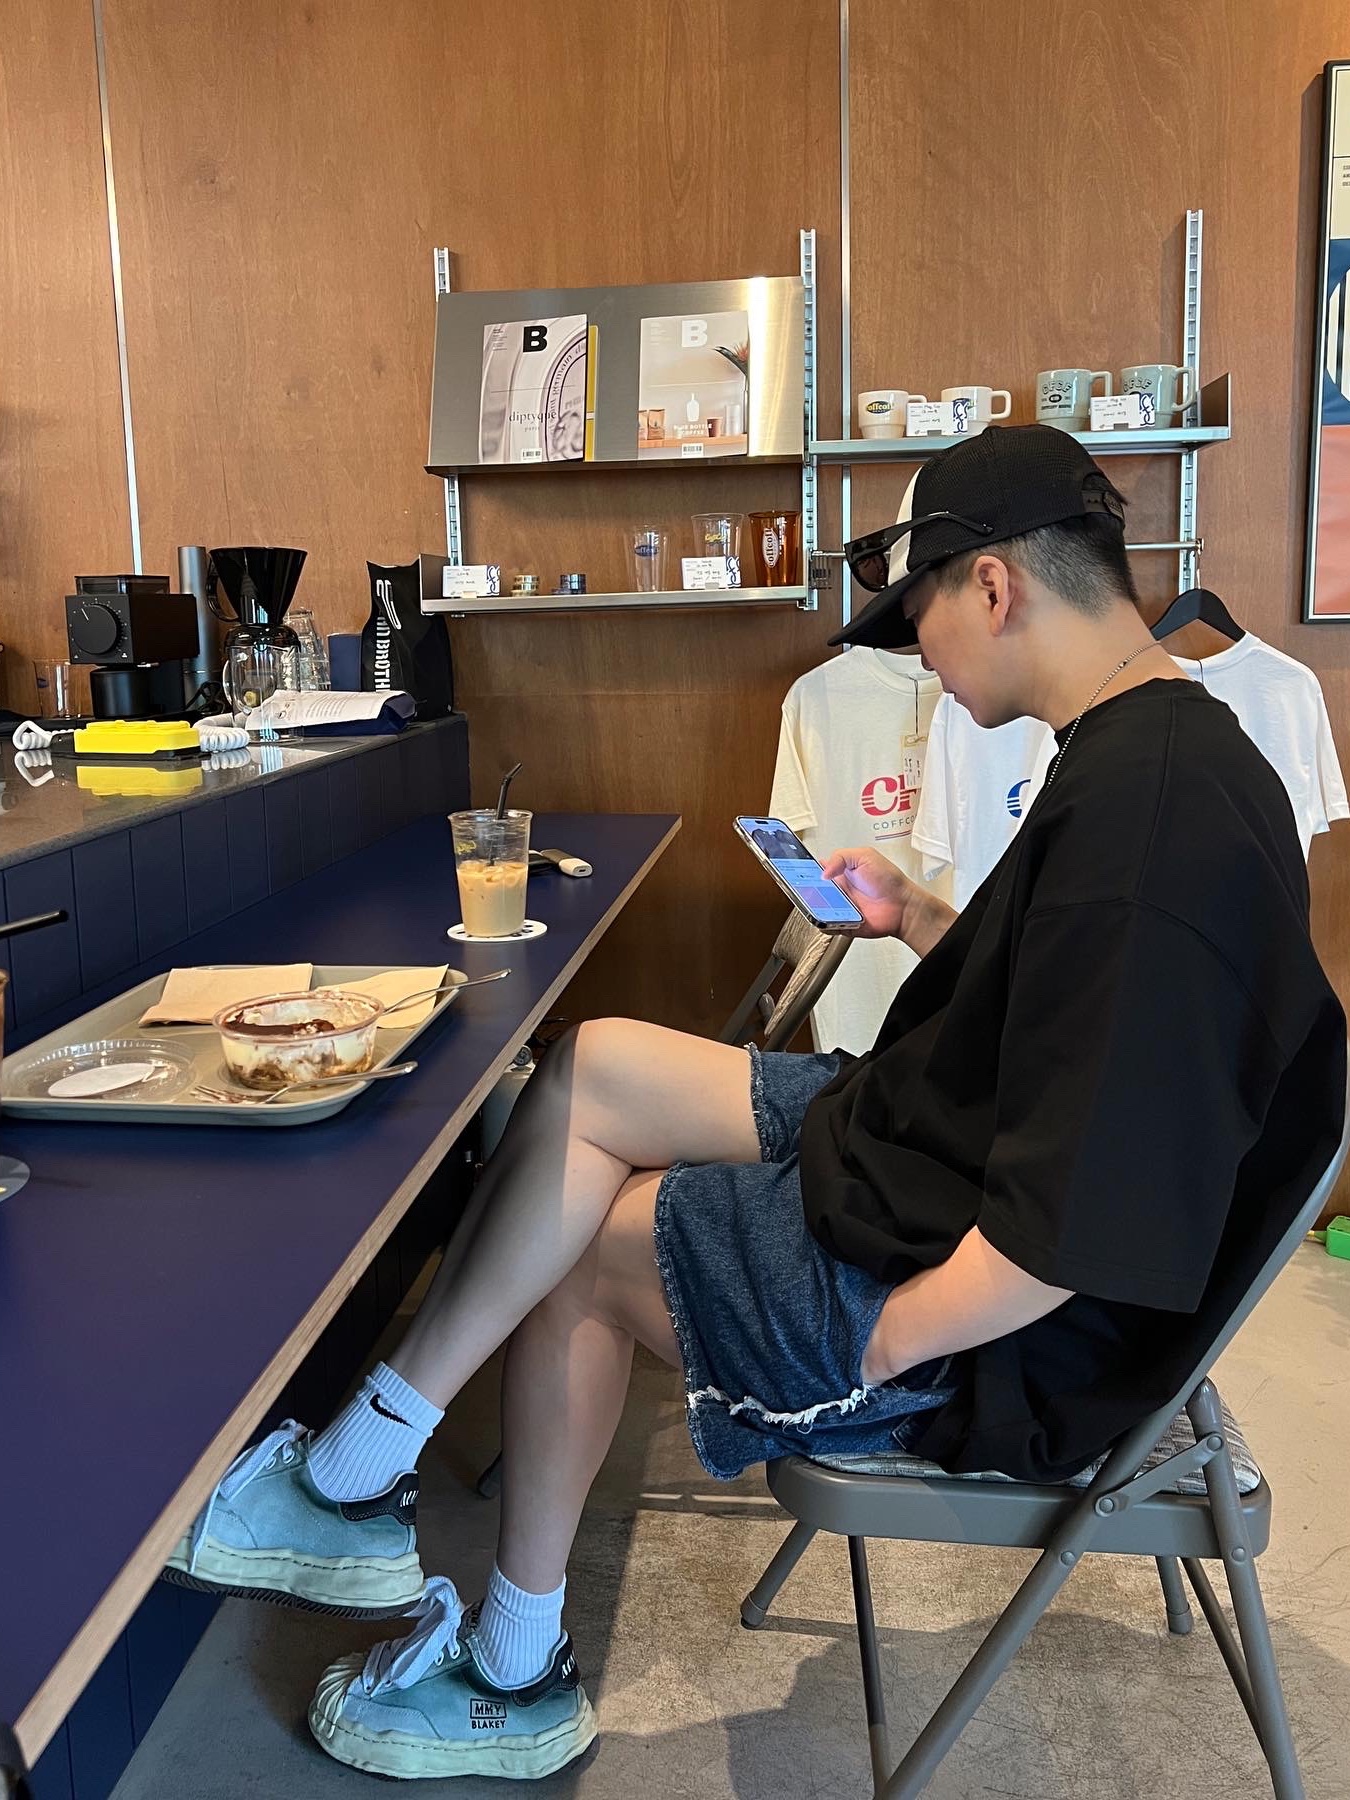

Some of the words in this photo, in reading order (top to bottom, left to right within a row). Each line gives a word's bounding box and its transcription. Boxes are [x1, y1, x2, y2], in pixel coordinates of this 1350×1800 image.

[522, 325, 548, 353] B
[681, 319, 708, 348] B
[509, 411, 557, 425] diptyque
[374, 639, 391, 692] BROTH
[873, 815, 917, 831] COFFCO
[474, 1702, 501, 1716] MMY
[471, 1719, 506, 1730] BLAKEY
